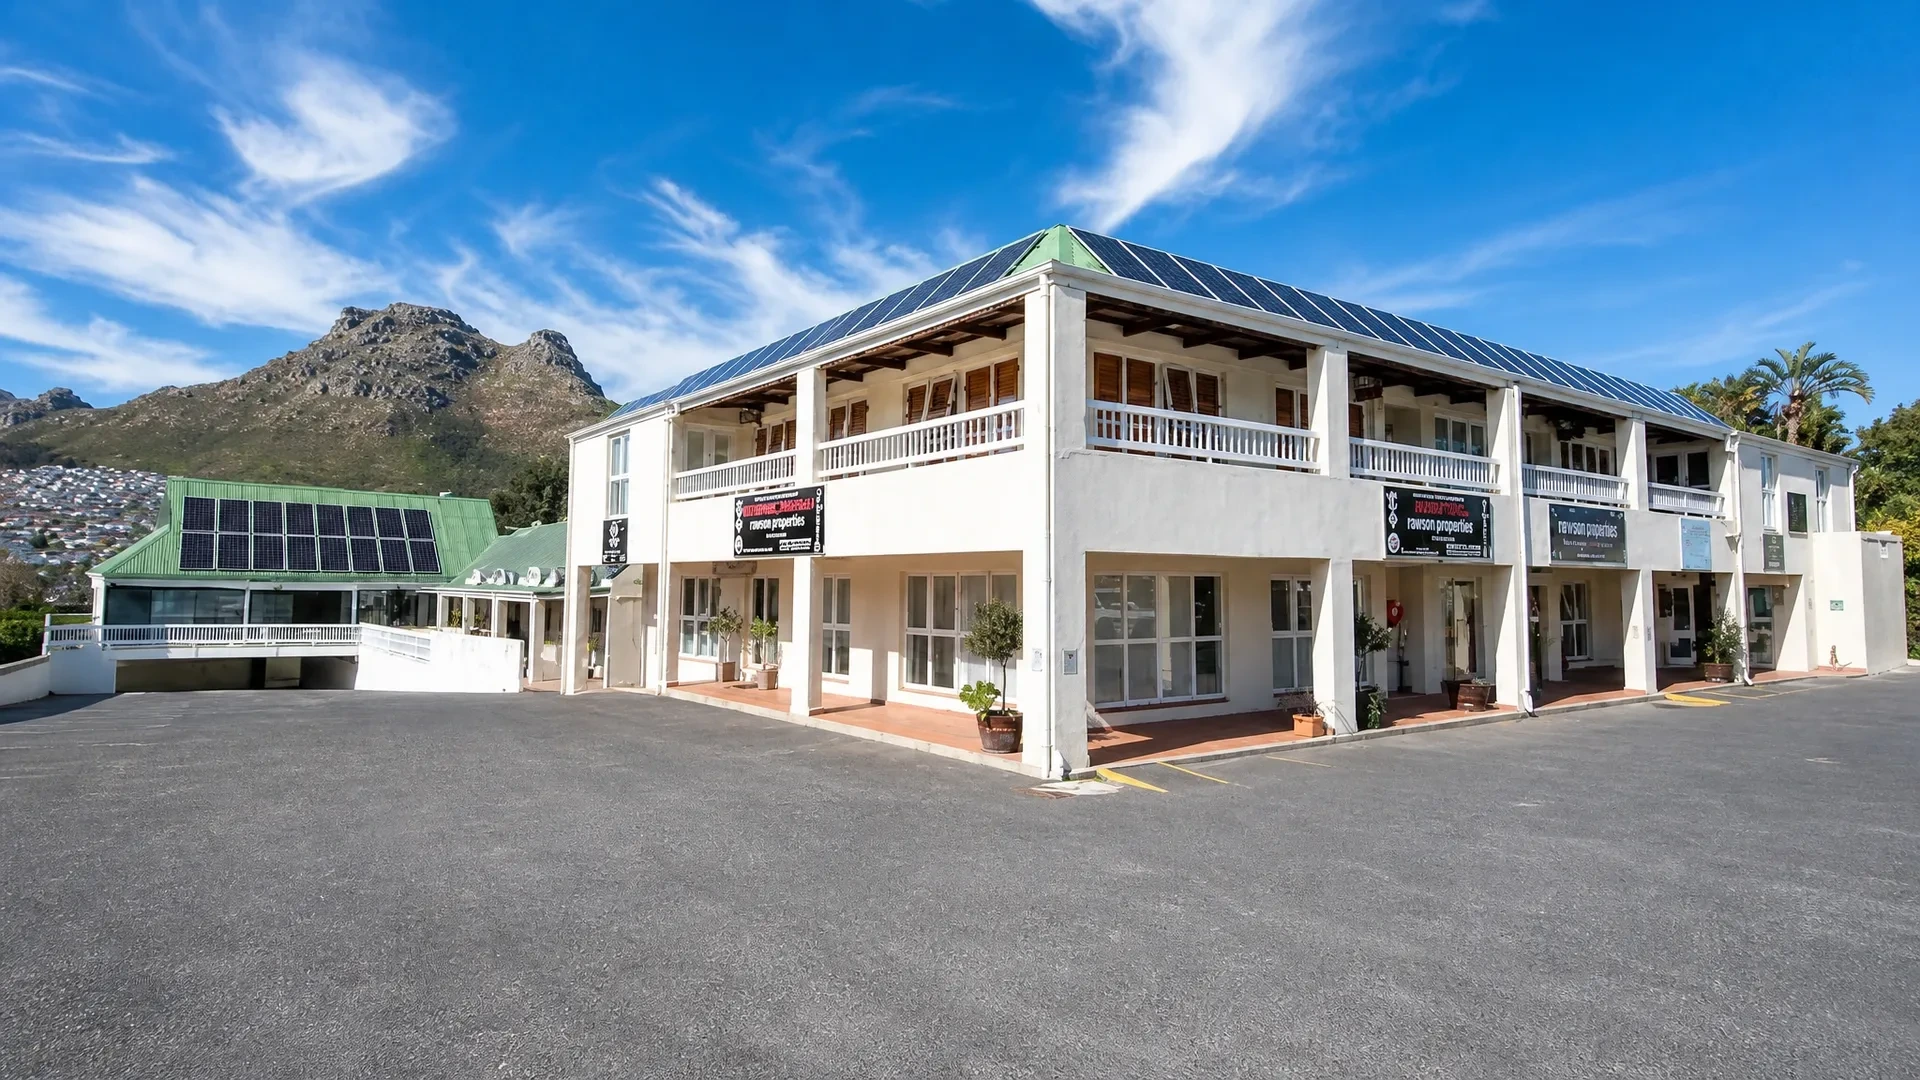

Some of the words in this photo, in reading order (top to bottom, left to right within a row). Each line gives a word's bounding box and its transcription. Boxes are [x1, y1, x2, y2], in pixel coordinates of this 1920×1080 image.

[771, 513, 805, 531] properties
[1407, 517, 1435, 531] rawson
[1436, 517, 1473, 535] properties
